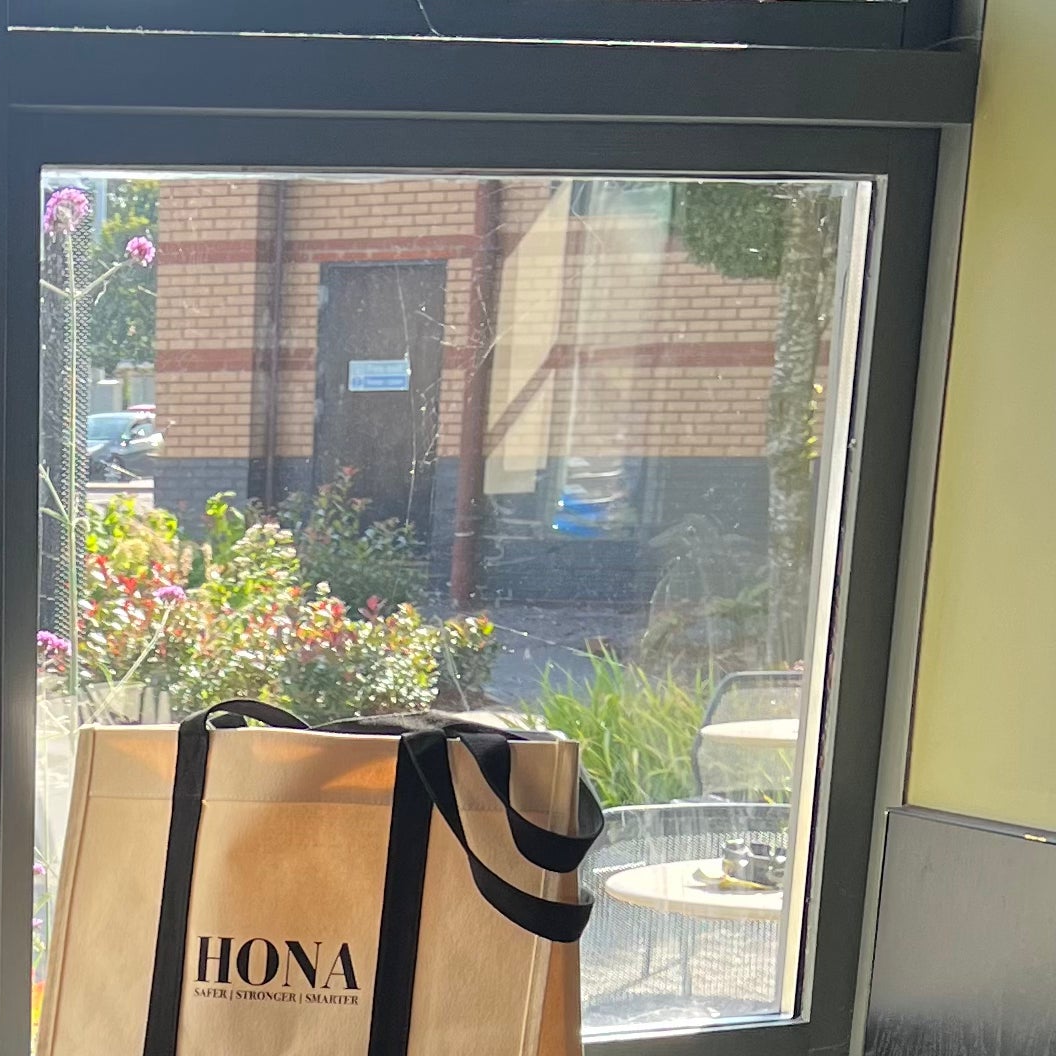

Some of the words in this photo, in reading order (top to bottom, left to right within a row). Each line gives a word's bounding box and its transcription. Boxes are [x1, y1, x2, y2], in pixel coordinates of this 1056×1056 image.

[195, 936, 361, 990] HONA
[194, 987, 228, 1000] SAFER
[235, 990, 297, 1002] STRONGER
[305, 993, 359, 1006] SMARTER
